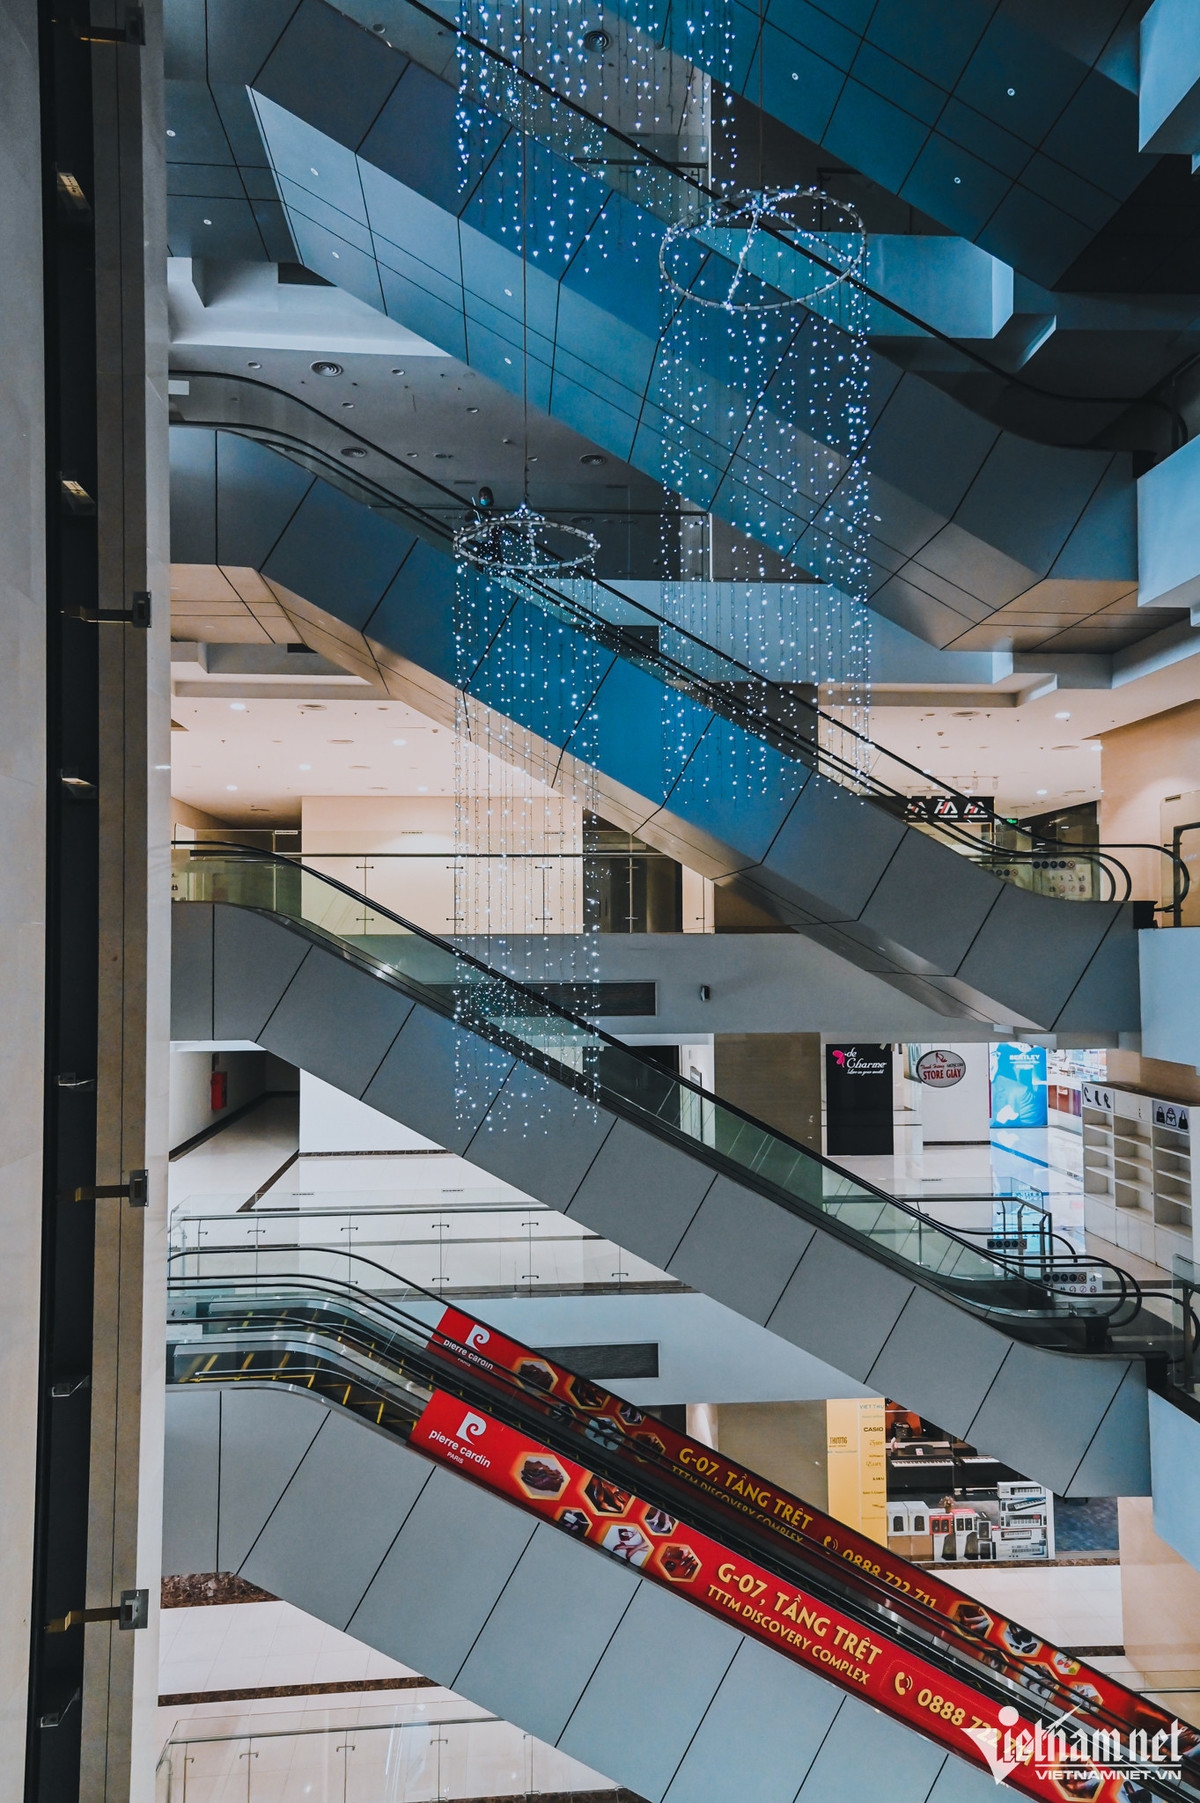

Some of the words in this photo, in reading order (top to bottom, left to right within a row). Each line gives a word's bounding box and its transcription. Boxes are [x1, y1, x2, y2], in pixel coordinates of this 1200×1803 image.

[846, 1058, 887, 1069] Charme
[923, 1070, 944, 1080] STORE
[428, 1430, 459, 1450] pierre
[460, 1447, 491, 1468] cardin
[447, 1451, 464, 1464] PARIS
[679, 1448, 720, 1482] G-07,
[718, 1563, 768, 1606] G-07,
[774, 1594, 831, 1637] TẦNG
[833, 1625, 882, 1665] TRỆT
[707, 1584, 739, 1612] TTTM
[742, 1605, 812, 1650] DISCOVERY
[811, 1645, 870, 1685] COMPLEX
[917, 1688, 966, 1726] 0888
